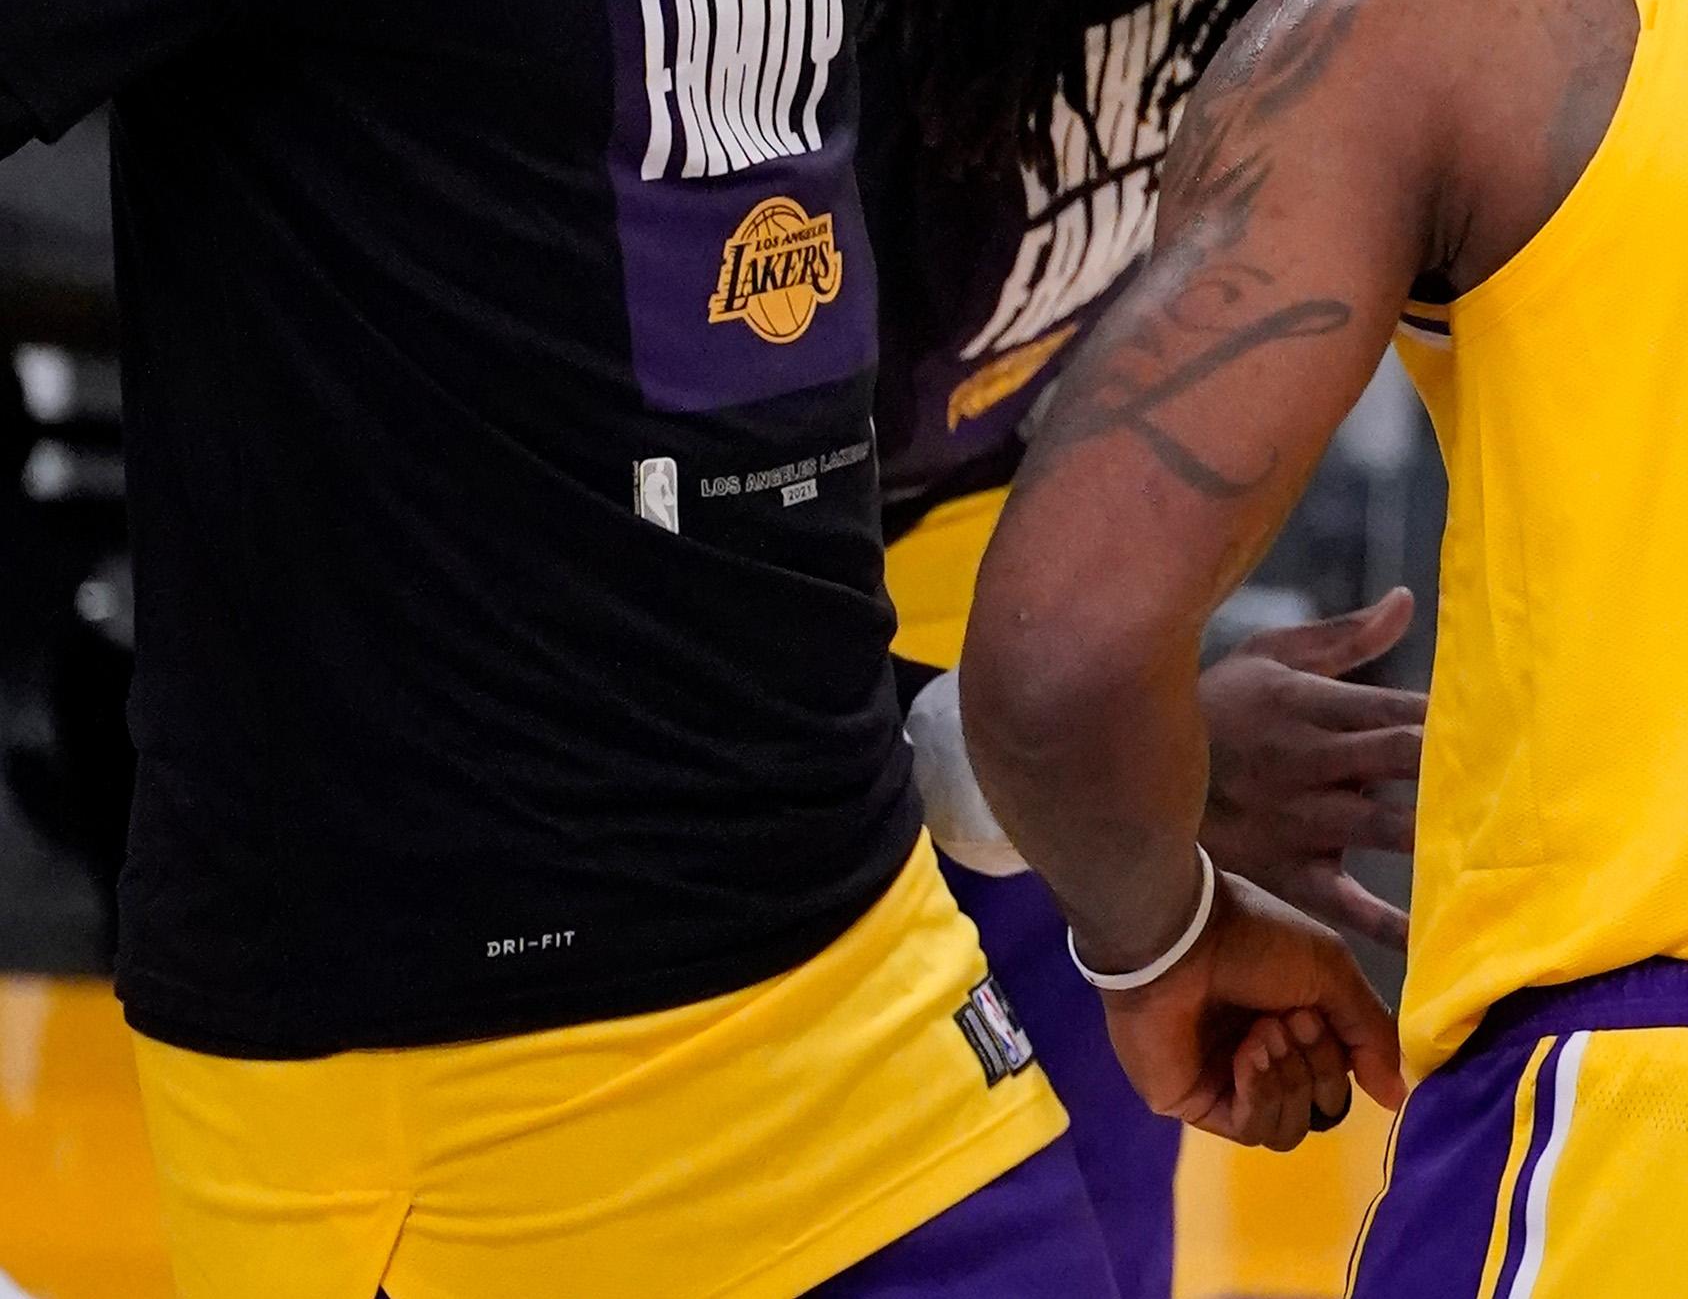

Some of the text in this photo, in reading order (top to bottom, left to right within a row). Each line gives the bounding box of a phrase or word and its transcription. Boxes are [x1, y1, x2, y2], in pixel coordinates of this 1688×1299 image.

[755, 235, 780, 252] LOS
[714, 241, 838, 314] LAKERS
[701, 475, 741, 497] LOS
[745, 457, 817, 492] ANGELES
[487, 930, 576, 958] DRI-FIT
